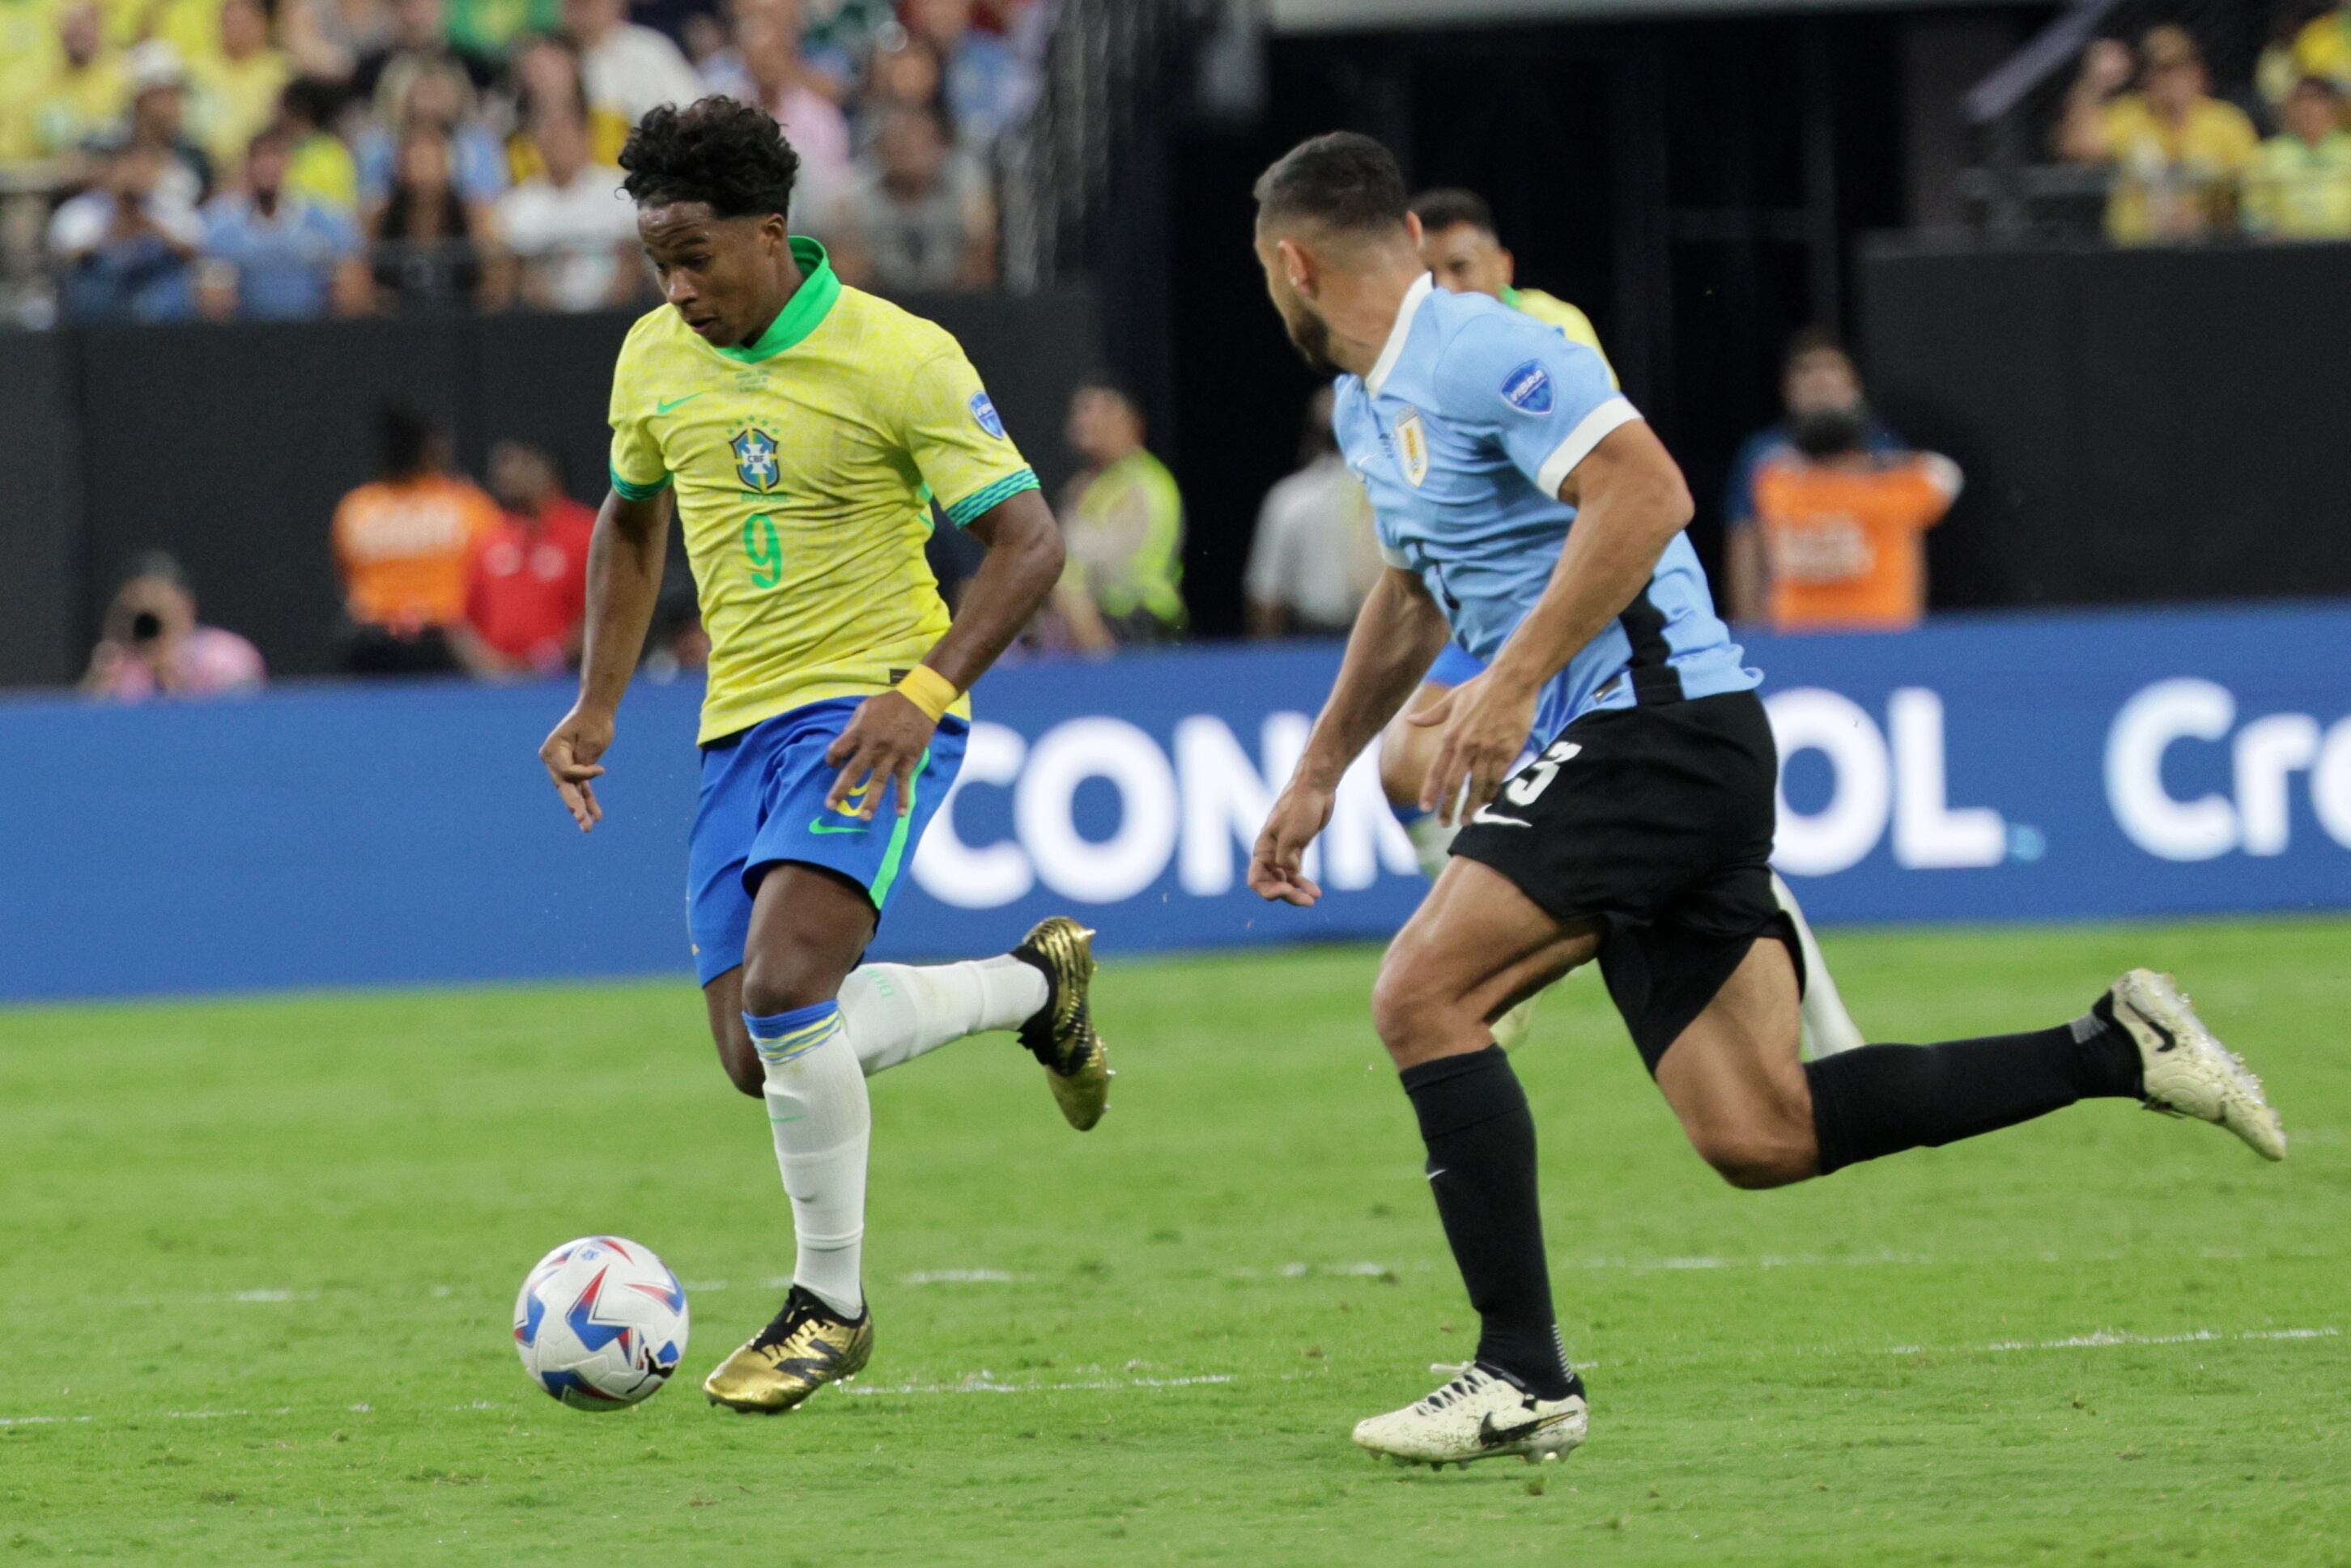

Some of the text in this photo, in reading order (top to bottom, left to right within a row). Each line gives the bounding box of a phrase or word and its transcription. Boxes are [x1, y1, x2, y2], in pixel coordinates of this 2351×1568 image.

[1511, 368, 1544, 402] VIBRA
[746, 454, 765, 464] CBF
[743, 512, 781, 589] 9
[910, 685, 2008, 909] CONOL
